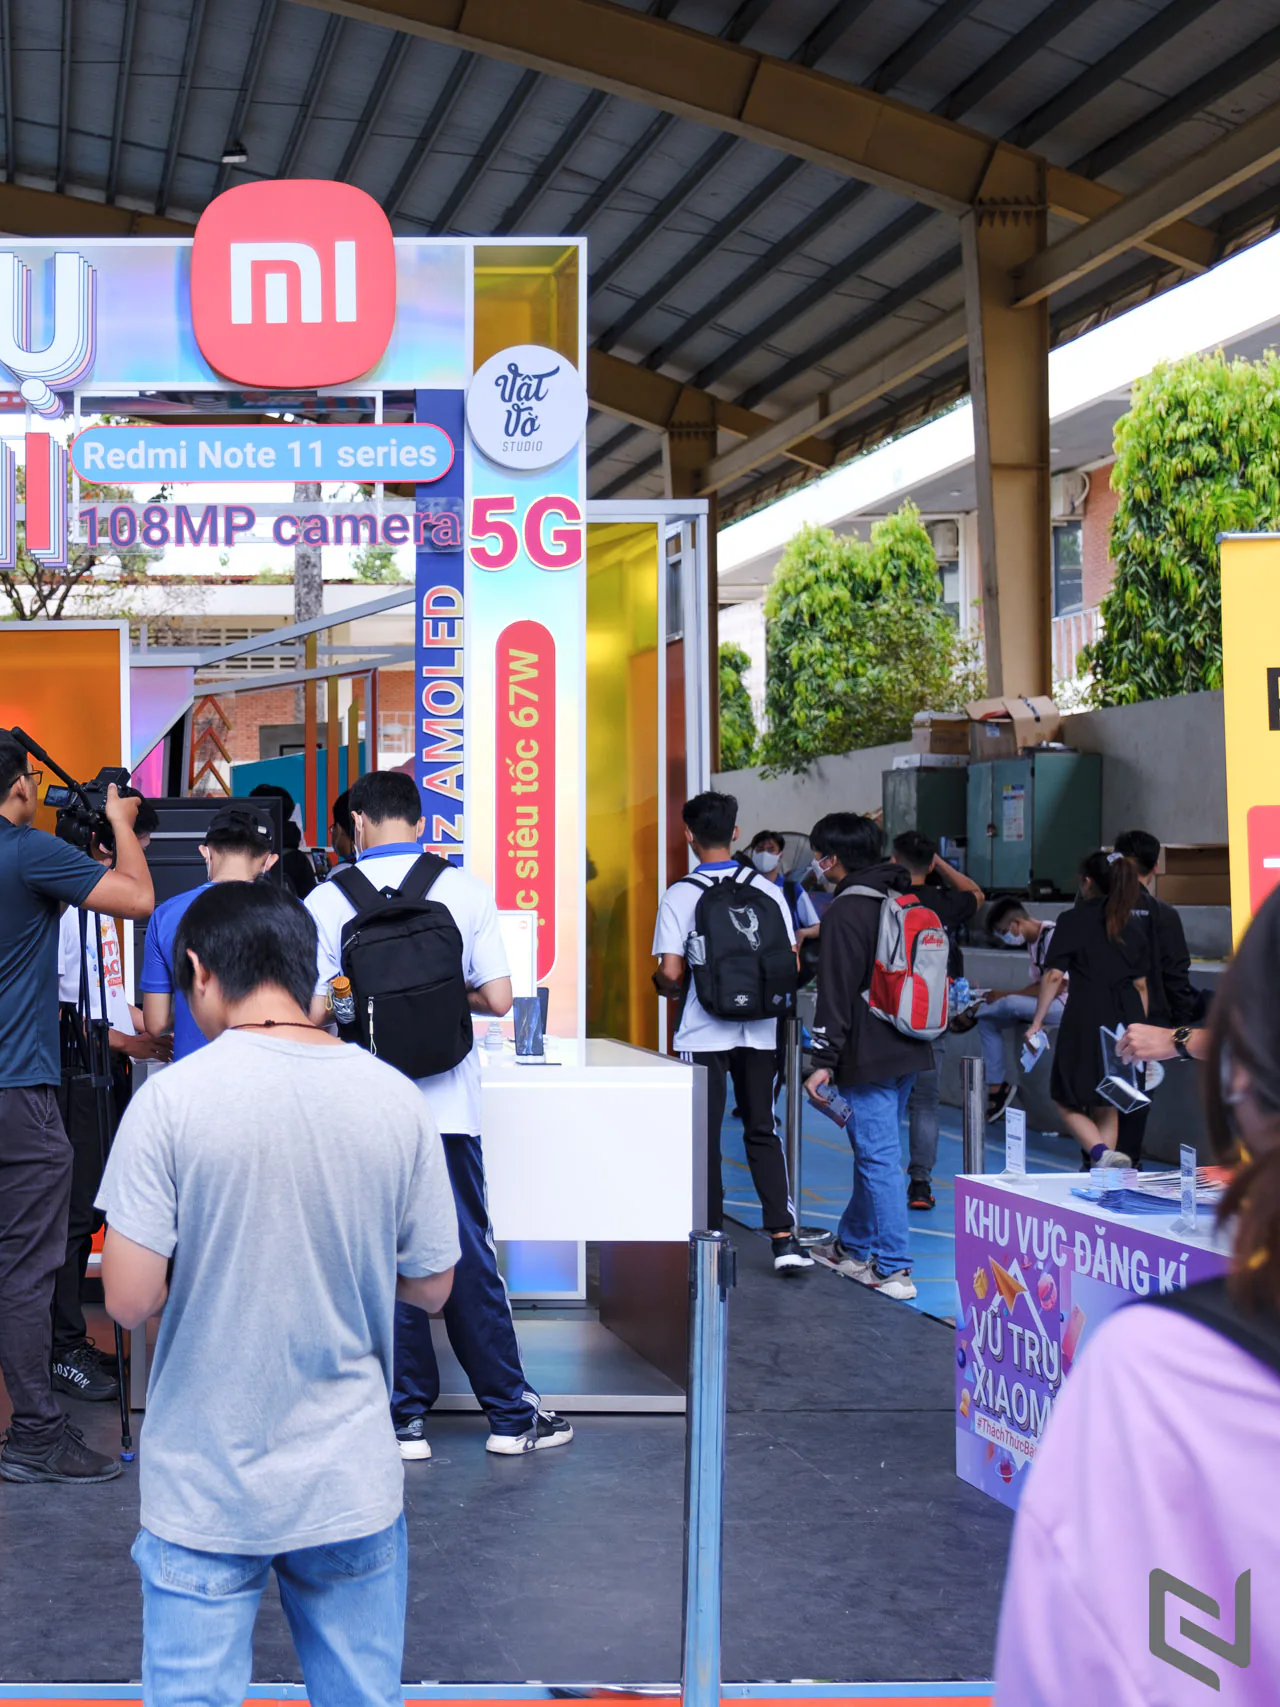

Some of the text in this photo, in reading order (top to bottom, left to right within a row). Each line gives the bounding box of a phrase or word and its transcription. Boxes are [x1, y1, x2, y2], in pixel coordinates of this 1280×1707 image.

[83, 438, 437, 470] Redmi Note 11 series
[502, 441, 543, 452] STUDIO
[79, 504, 461, 548] 108MP camera
[469, 495, 584, 570] 5G
[422, 585, 464, 801] AMOLED
[509, 649, 539, 727] 67W
[506, 739, 539, 795] tốc
[508, 806, 539, 879] siêu
[965, 1195, 1010, 1247] KHU
[1015, 1212, 1068, 1270] VỰC
[1073, 1224, 1150, 1296] ĐĂNG
[971, 1304, 1061, 1398] VŨ TRỤ
[972, 1360, 1054, 1438] XIAOM
